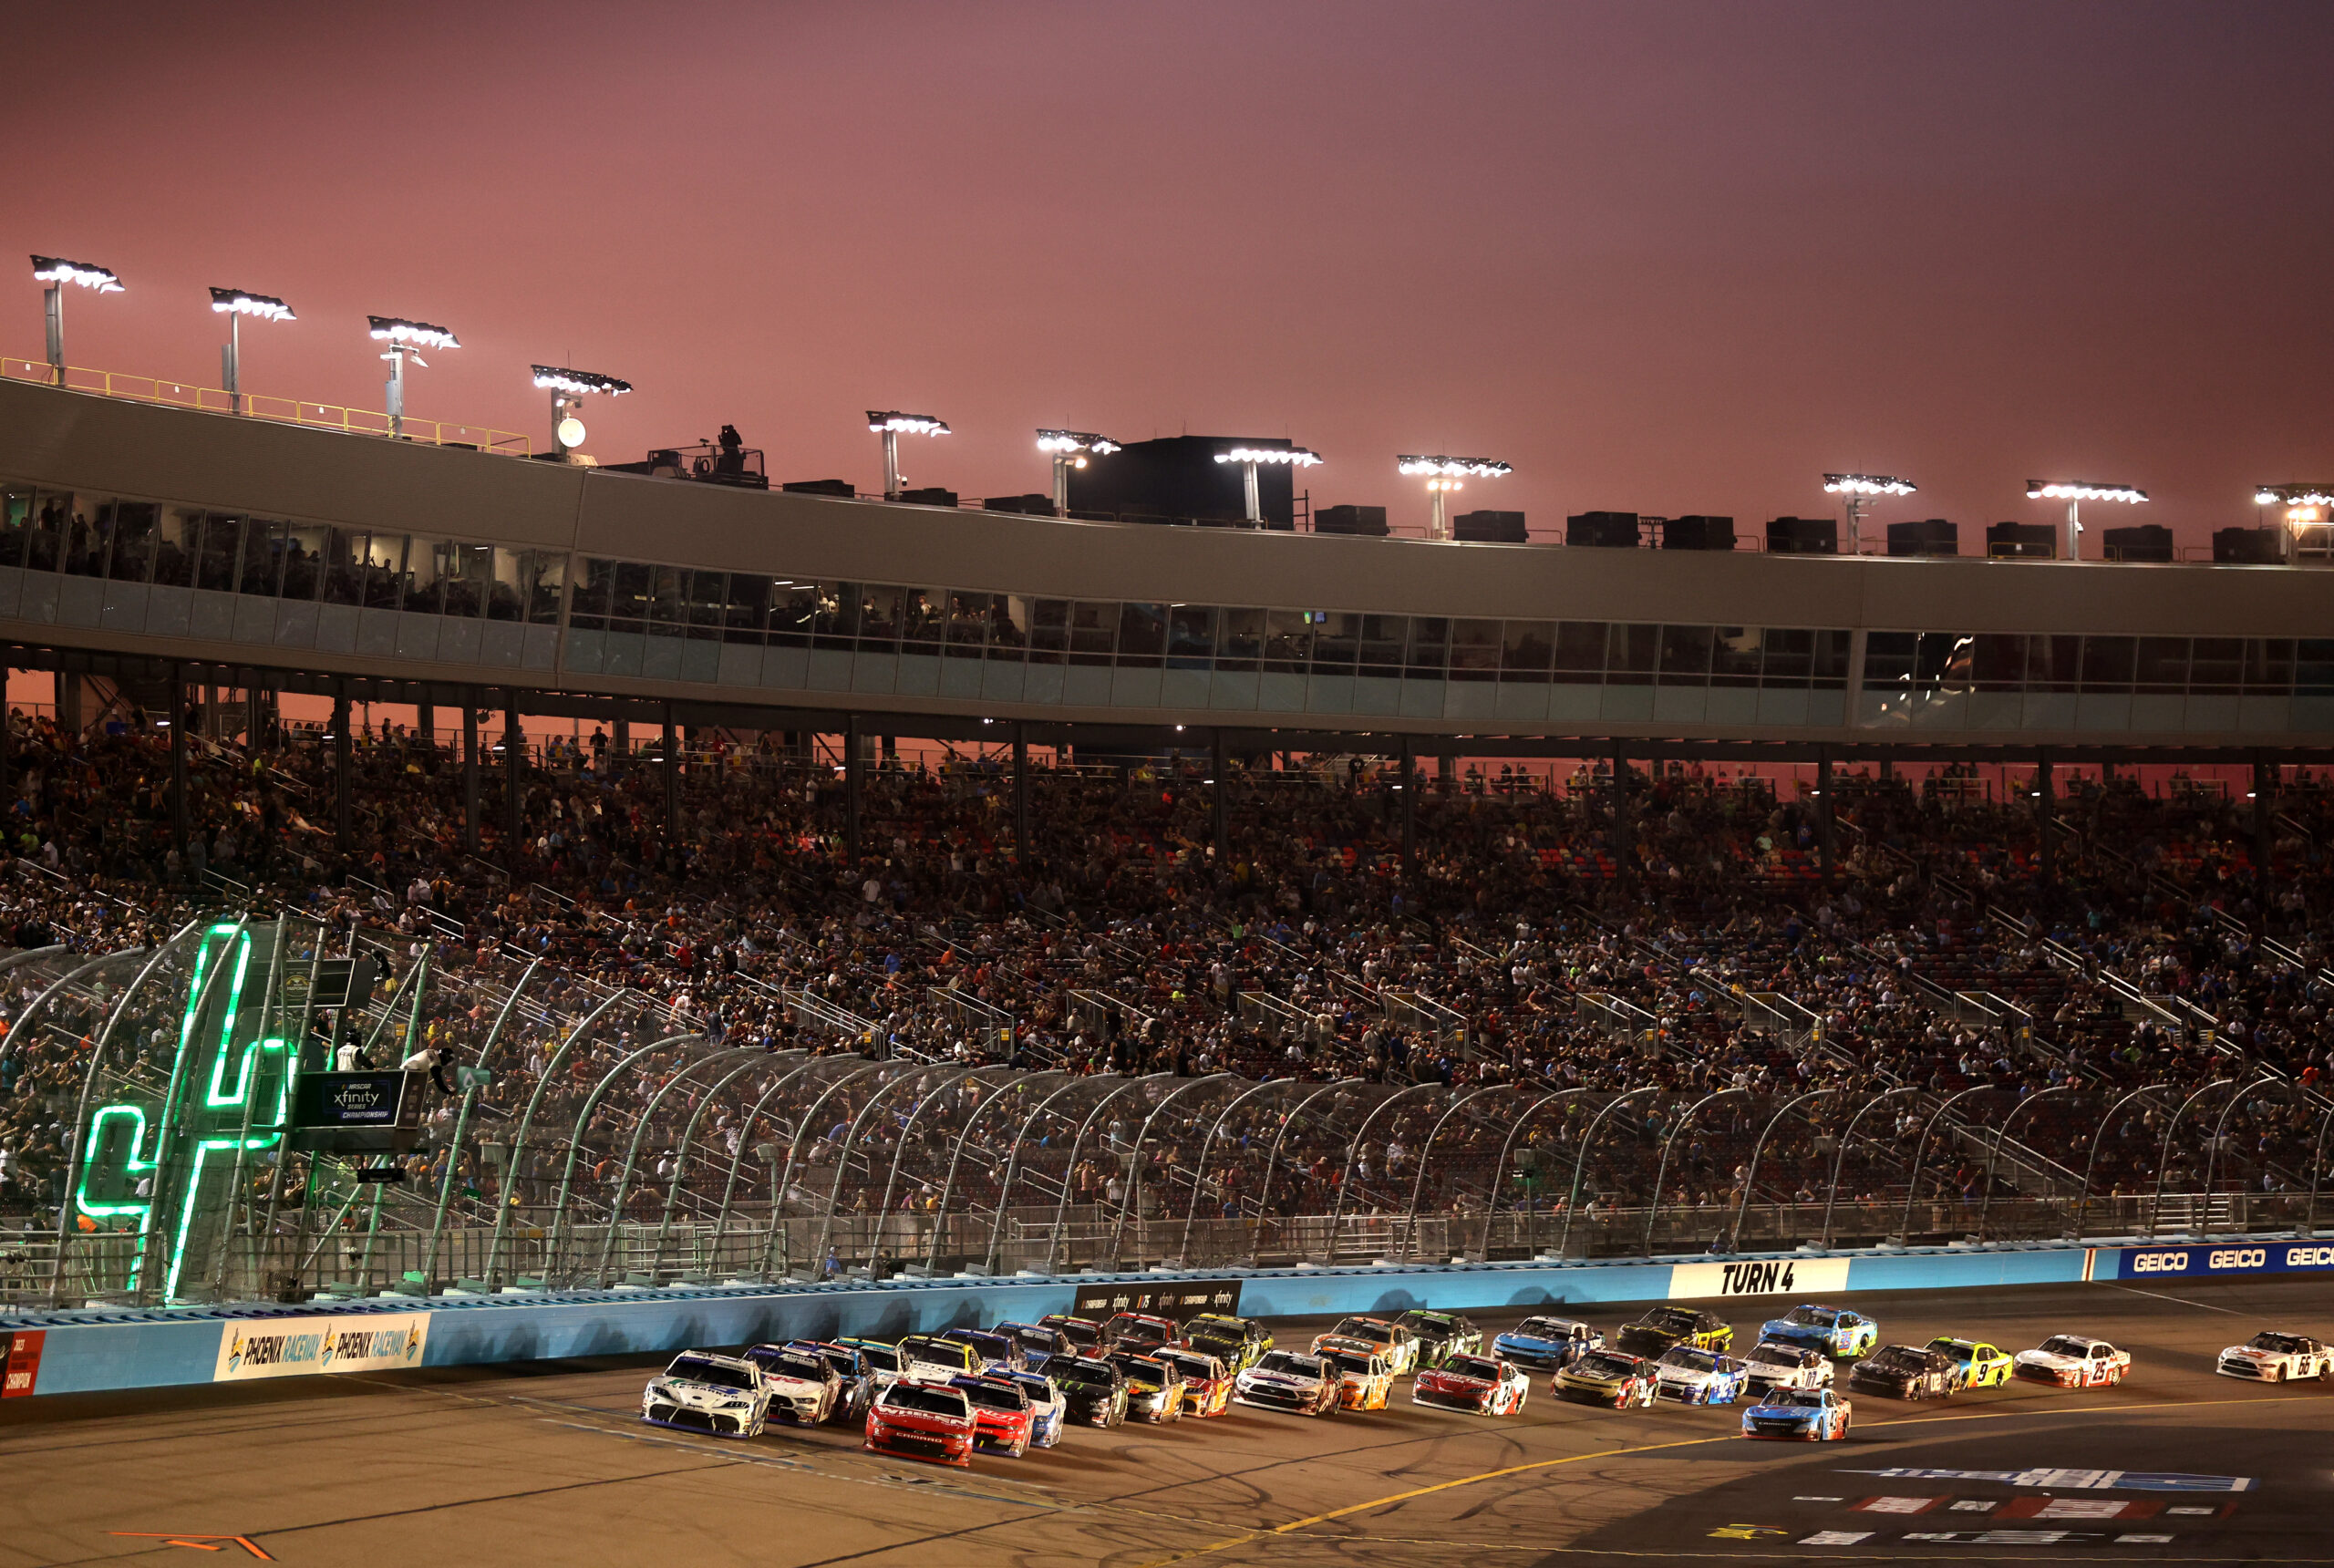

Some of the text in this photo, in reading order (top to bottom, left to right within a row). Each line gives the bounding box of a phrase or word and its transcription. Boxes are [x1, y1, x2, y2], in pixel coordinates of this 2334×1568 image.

[334, 1090, 379, 1107] xfinity
[2133, 1253, 2188, 1273] GEICO
[2209, 1249, 2266, 1269] GEICO
[2287, 1247, 2334, 1266] GEIC
[1721, 1262, 1794, 1295] TURN 4
[1112, 1293, 1130, 1312] xfinity
[1158, 1292, 1176, 1310] xfinity
[1213, 1289, 1233, 1308] xfinity
[243, 1334, 323, 1365] PHOENIX RACEWAY
[336, 1329, 408, 1359] PHOENIX RACEWAY
[787, 1355, 813, 1363] CUSTER
[2298, 1356, 2311, 1376] 66
[5, 1372, 32, 1389] CHAMPION
[1977, 1364, 1988, 1383] 9
[2092, 1361, 2107, 1381] 25
[1930, 1373, 1942, 1392] 02
[877, 1405, 972, 1428] WHELEN
[896, 1431, 943, 1443] CAMARO
